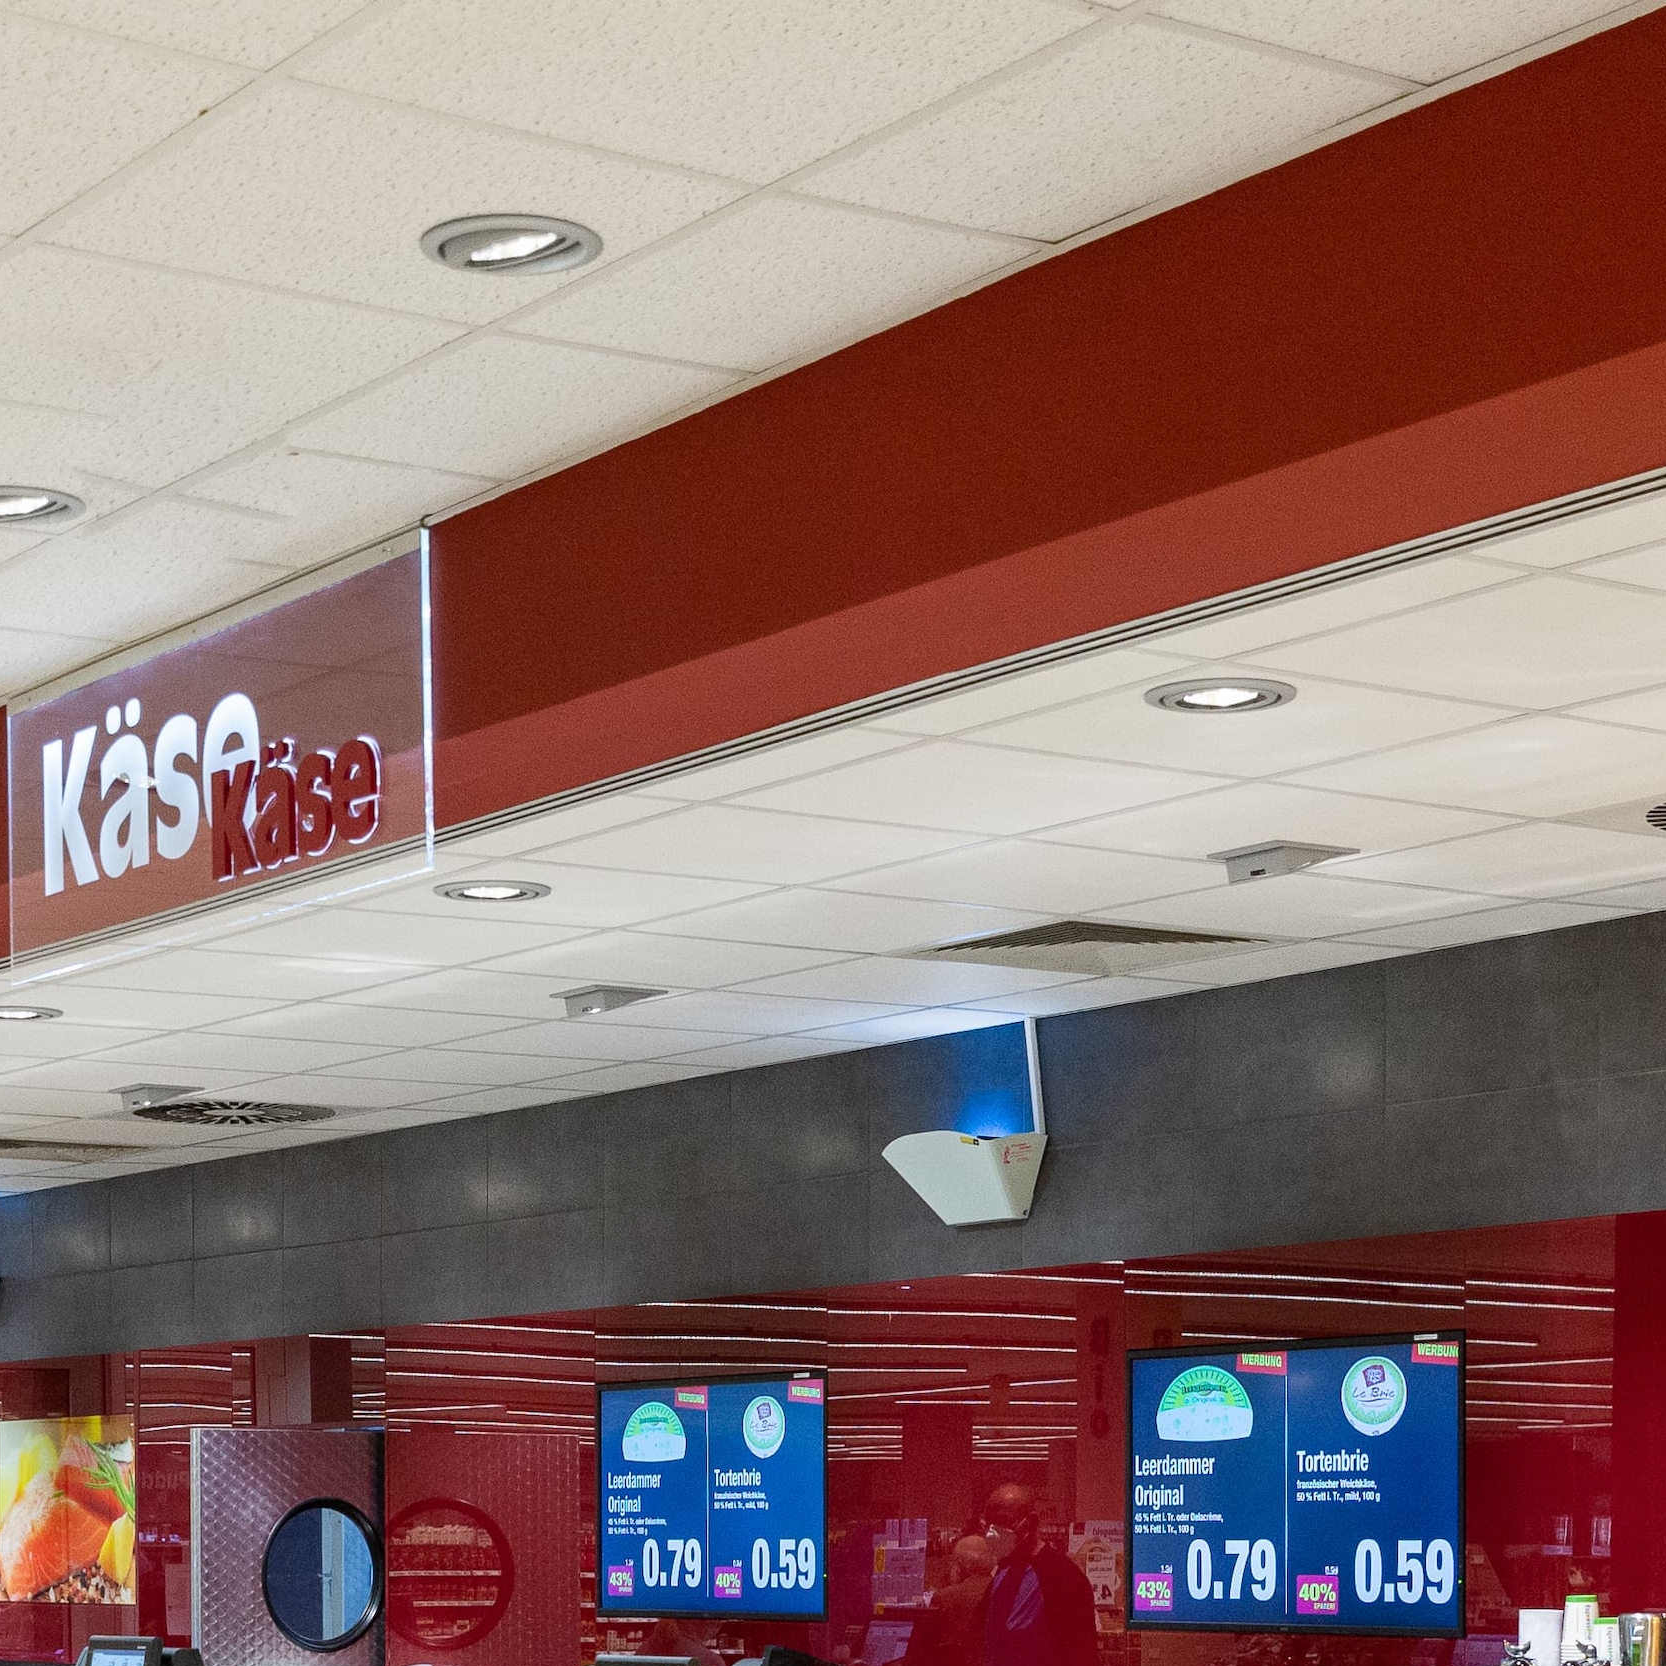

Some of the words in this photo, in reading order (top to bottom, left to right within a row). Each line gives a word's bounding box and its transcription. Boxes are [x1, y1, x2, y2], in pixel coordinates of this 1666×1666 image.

[42, 692, 260, 897] Käse
[212, 736, 382, 882] Käse
[1241, 1353, 1282, 1368] WERBUNG
[1135, 1455, 1215, 1477] Leerdammer
[1296, 1449, 1369, 1474] Tortenbrie
[608, 1472, 662, 1489] Leerdammer
[714, 1468, 762, 1487] Tortenbrie
[608, 1496, 641, 1516] Original
[1135, 1485, 1184, 1511] Original
[1362, 1491, 1374, 1501] 100
[642, 1537, 702, 1588] 0.79
[751, 1537, 816, 1589] 0.59
[1186, 1539, 1277, 1602] 0.79
[1354, 1538, 1455, 1604] 0.59
[609, 1572, 633, 1587] 43%
[716, 1572, 741, 1588] 40%
[1136, 1581, 1171, 1600] 43%
[1298, 1583, 1337, 1602] 40%
